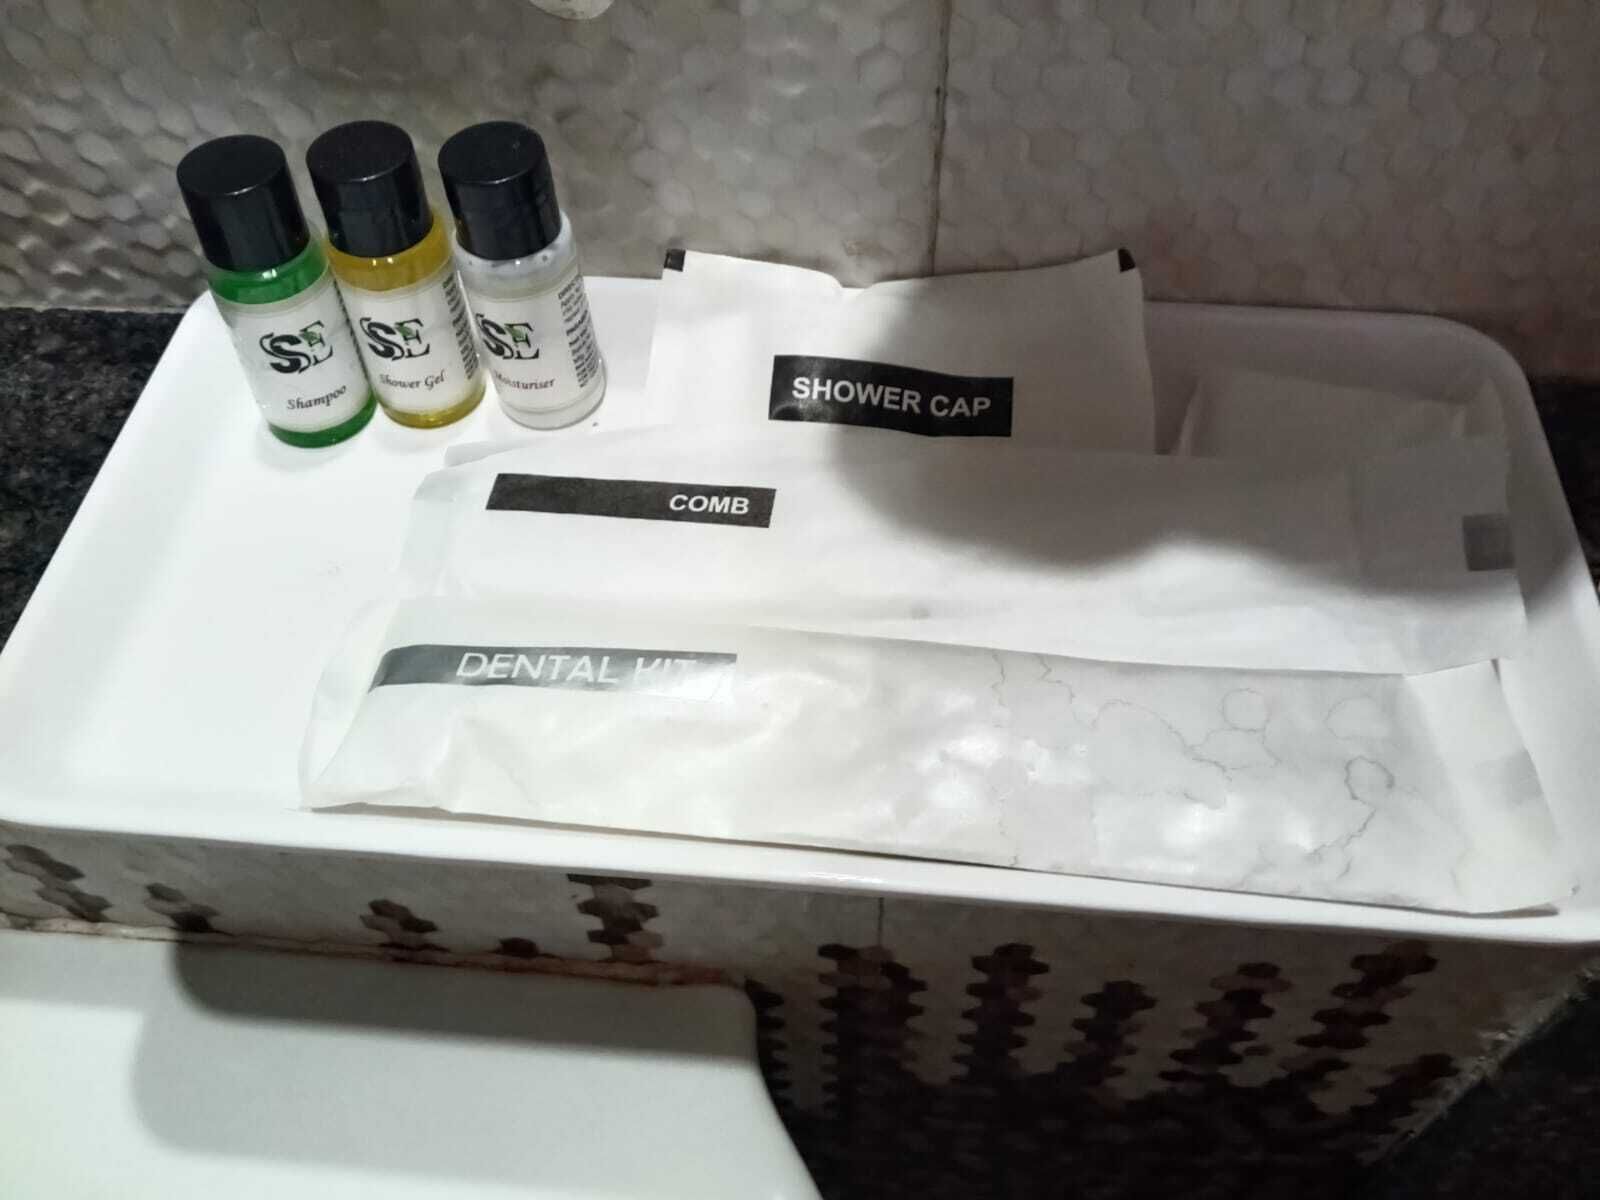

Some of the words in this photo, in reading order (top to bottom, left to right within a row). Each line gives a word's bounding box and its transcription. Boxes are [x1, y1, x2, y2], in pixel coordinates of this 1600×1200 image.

[380, 373, 420, 389] Shower
[424, 369, 445, 391] Gel
[286, 385, 347, 410] Shampoo
[792, 376, 921, 413] SHOWER
[930, 395, 991, 417] CAP
[669, 494, 750, 515] COMB
[456, 652, 620, 684] DENTAL
